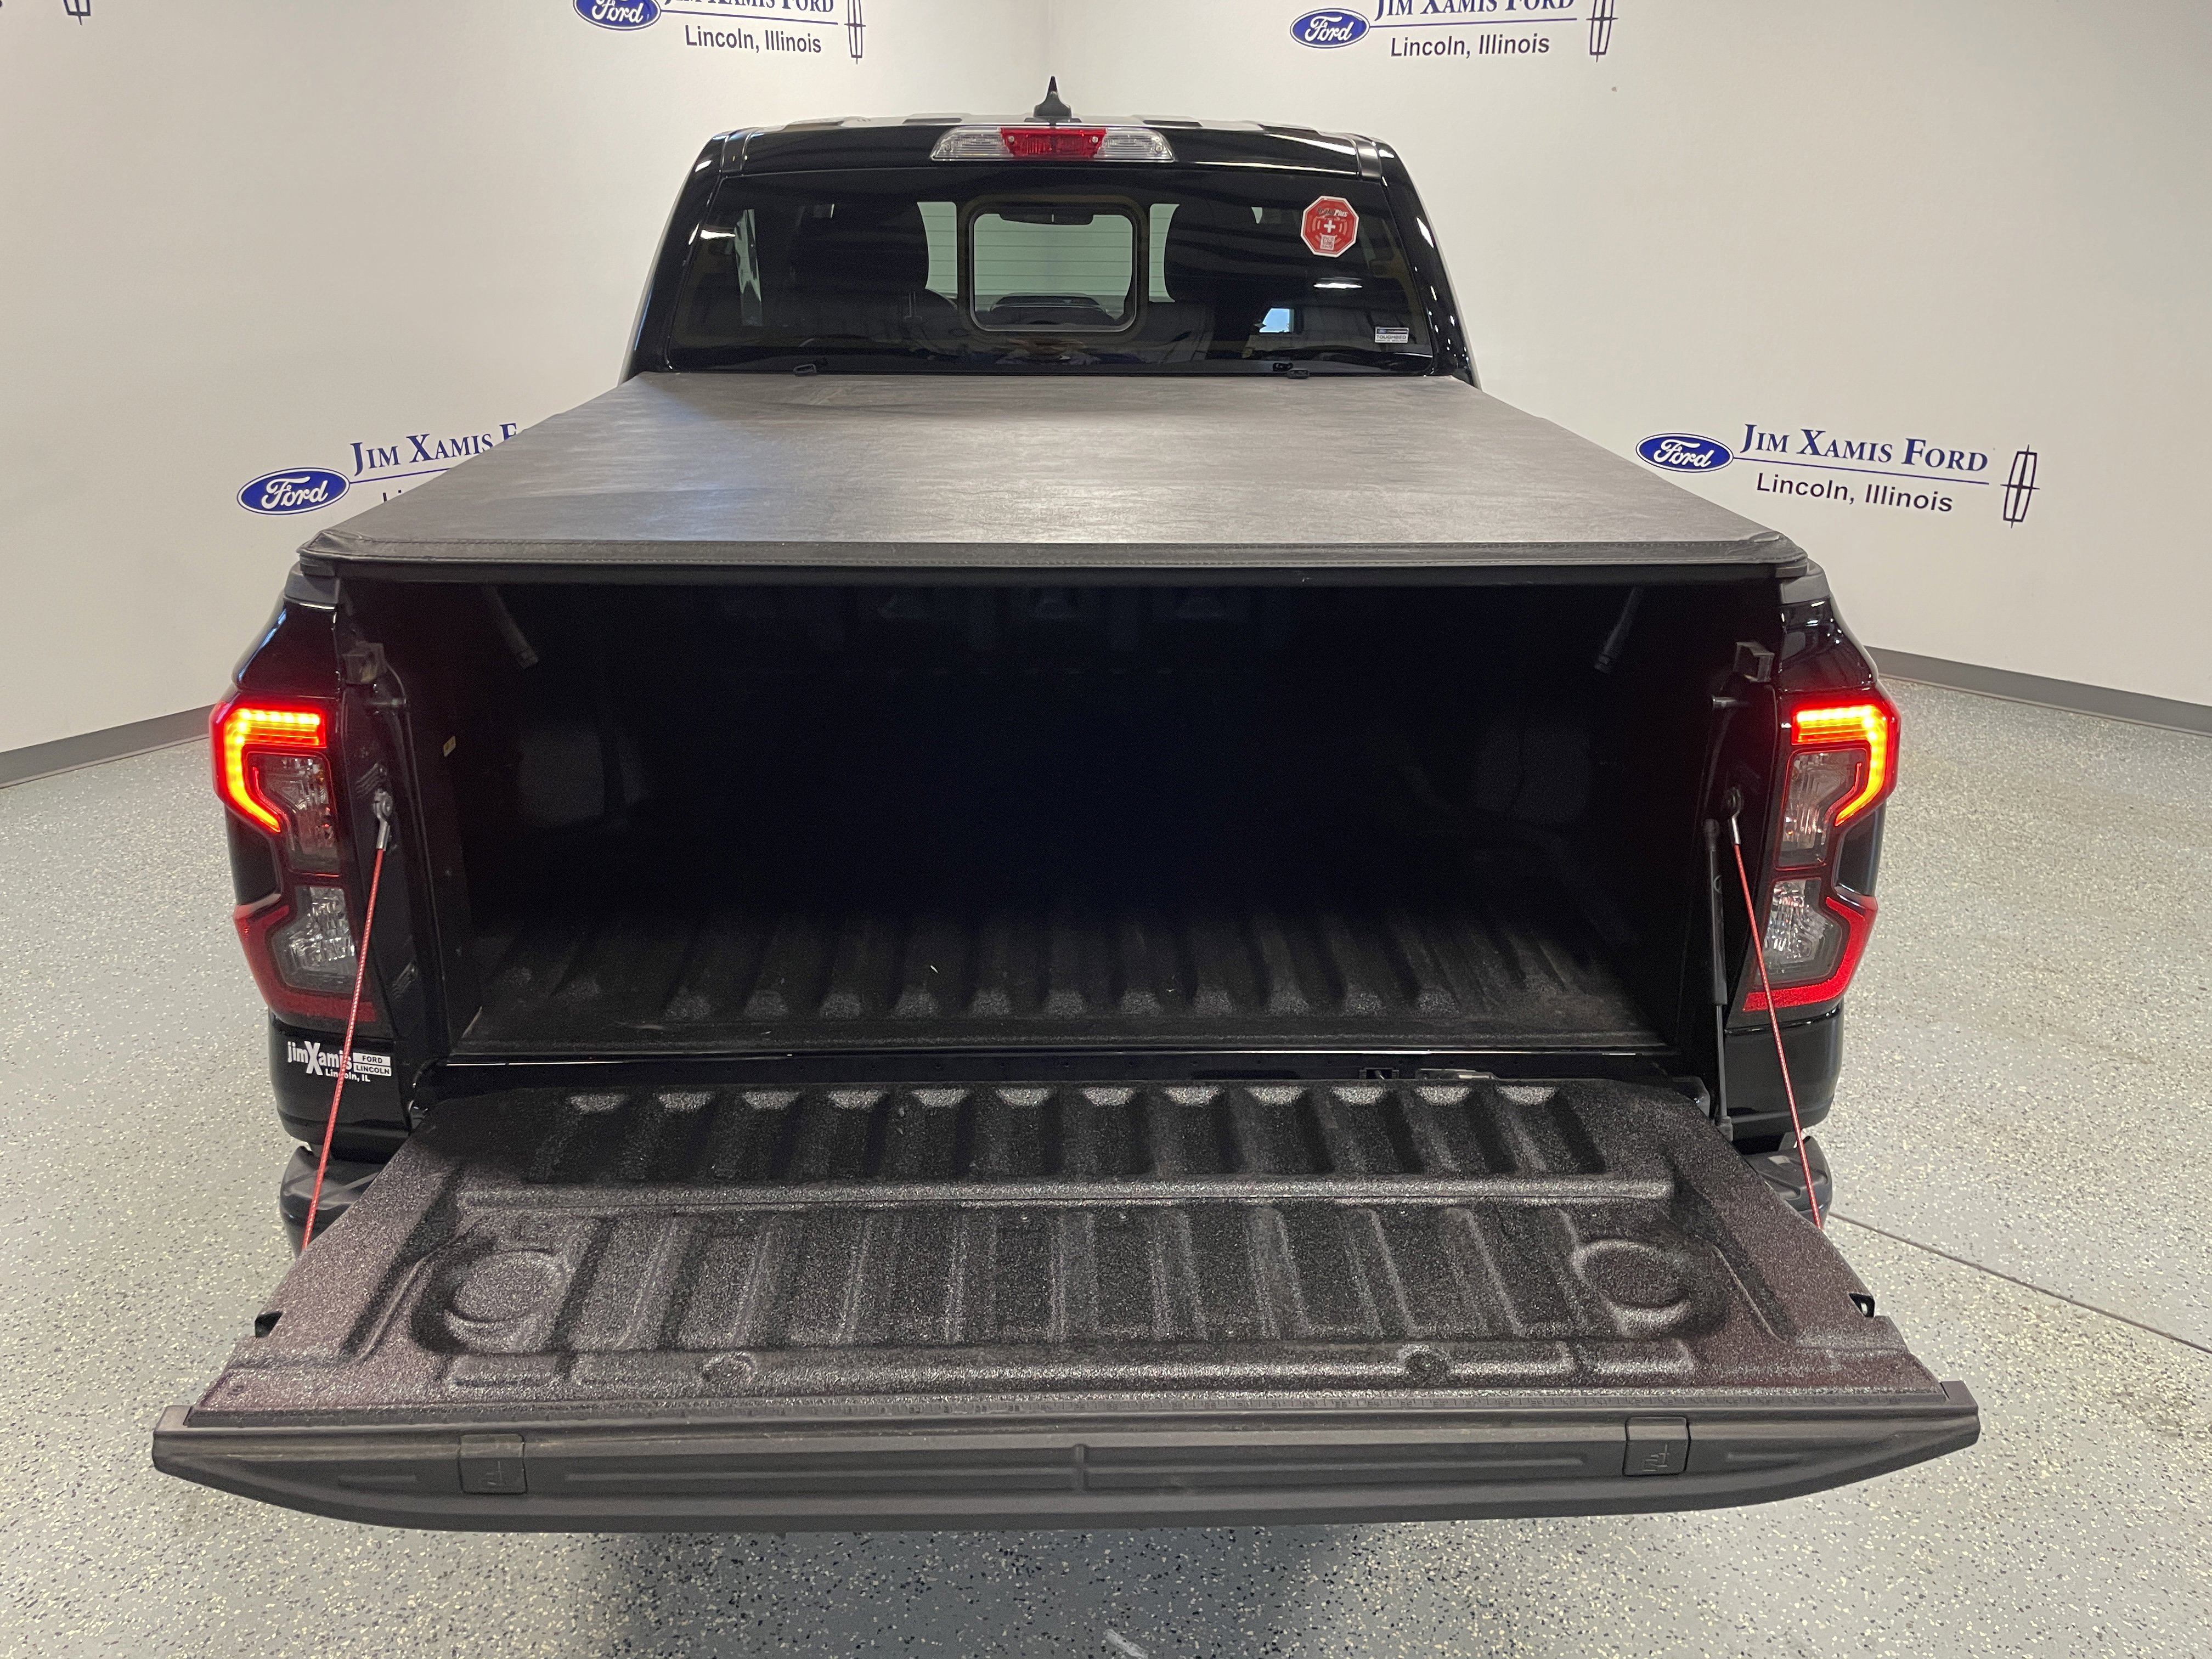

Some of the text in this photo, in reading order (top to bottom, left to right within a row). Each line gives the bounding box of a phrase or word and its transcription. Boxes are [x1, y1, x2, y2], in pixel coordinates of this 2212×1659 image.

[591, 0, 644, 23] Ford
[685, 25, 822, 53] Lincoln, Illinois
[1304, 16, 1352, 42] Ford
[1391, 33, 1549, 59] Lincoln, Illinois
[349, 433, 493, 476] JIM XAMIS
[1654, 438, 1712, 469] Ford
[1740, 424, 1989, 471] JIM XAMIS FORD
[261, 476, 329, 510] Ford
[1757, 472, 1953, 512] Lincoln, Illinois
[356, 1064, 390, 1075] LINCOLN
[362, 1054, 383, 1064] FORD
[325, 1068, 371, 1082] Linoln, IL
